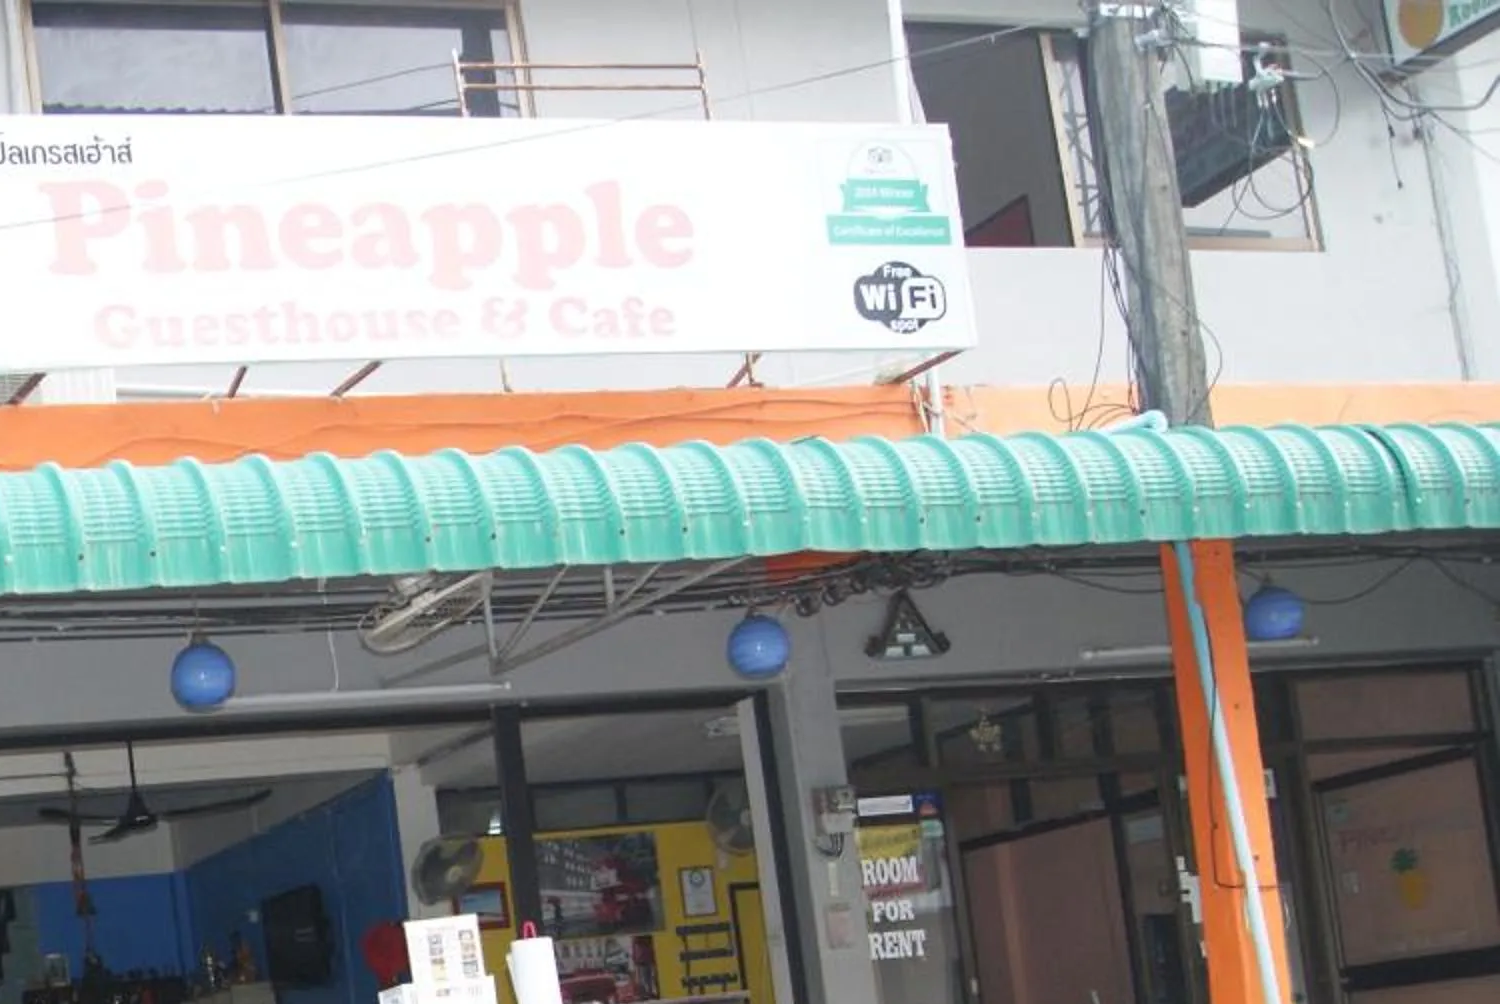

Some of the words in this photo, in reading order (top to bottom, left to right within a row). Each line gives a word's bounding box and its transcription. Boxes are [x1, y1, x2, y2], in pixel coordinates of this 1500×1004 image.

[38, 180, 694, 290] Pineapple
[883, 264, 912, 278] Free
[93, 299, 461, 350] Guesthouse
[481, 296, 529, 340] &
[548, 296, 676, 339] Cafe
[890, 319, 920, 334] spot
[861, 855, 920, 886] ROOM
[871, 900, 915, 922] FOR
[867, 929, 926, 960] RENT
